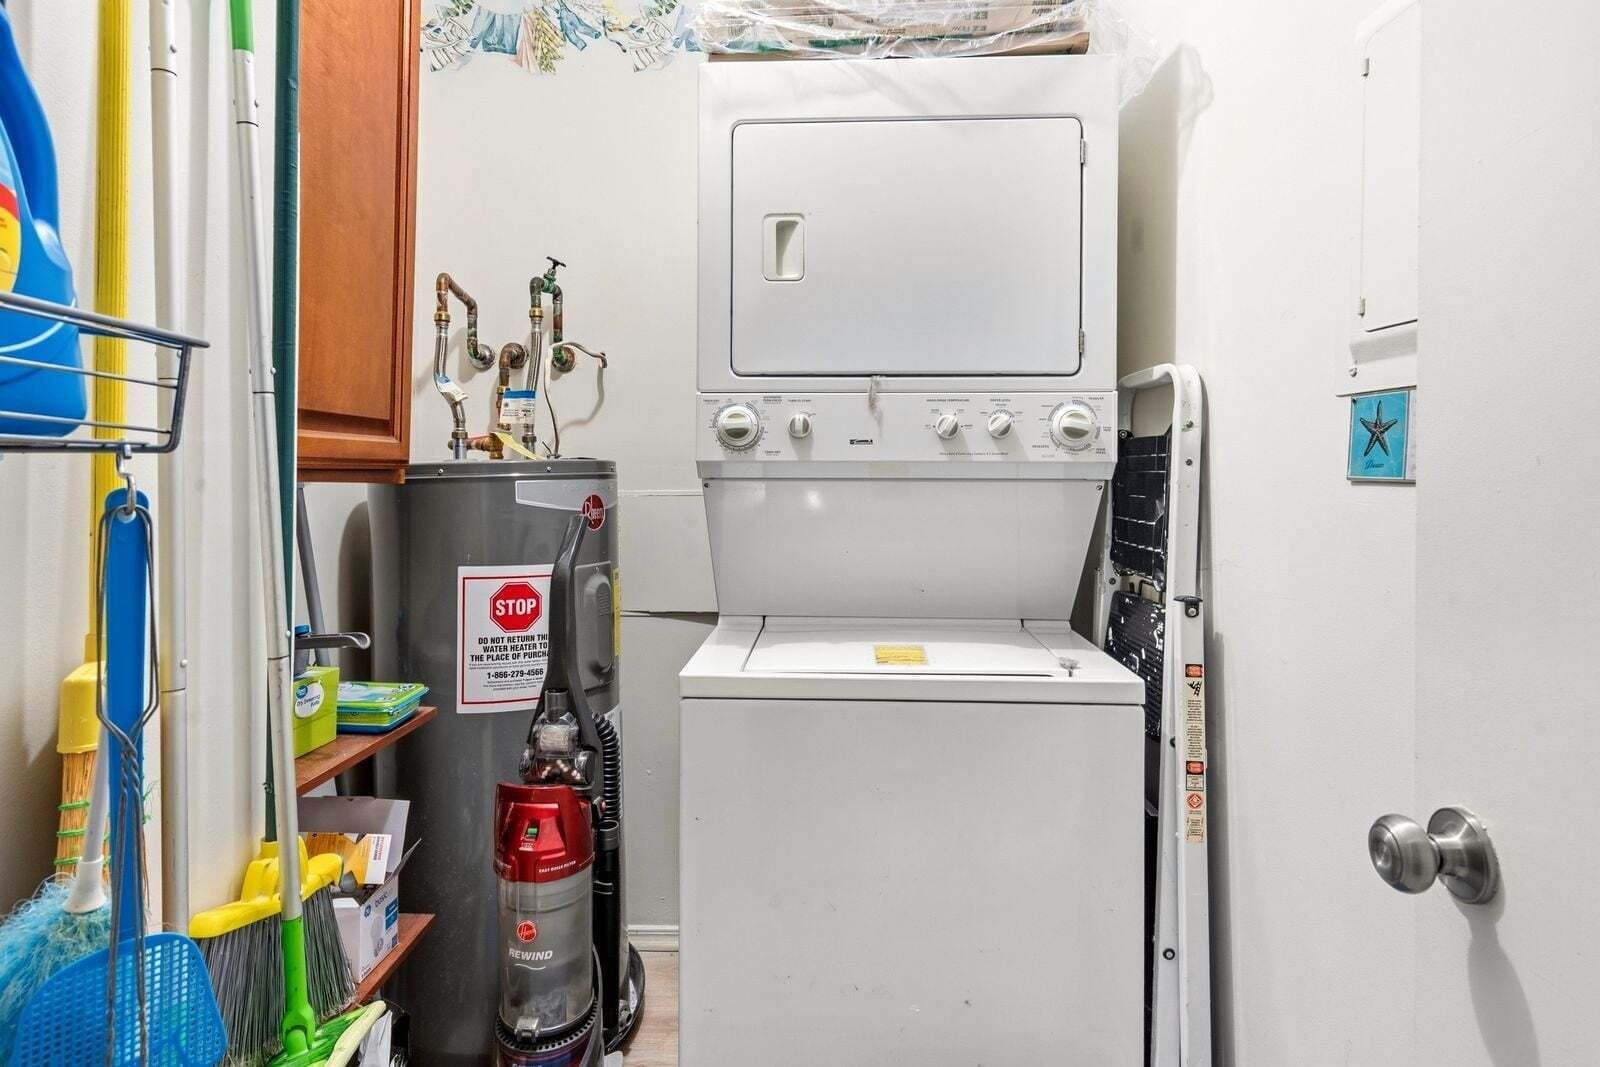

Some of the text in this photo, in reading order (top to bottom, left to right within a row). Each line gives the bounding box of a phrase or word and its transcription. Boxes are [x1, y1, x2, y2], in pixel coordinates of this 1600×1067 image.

[495, 598, 537, 617] STOP
[478, 633, 549, 645] DO NOT RETURN THI
[482, 645, 509, 653] WATER
[509, 643, 537, 652] HEATER
[470, 654, 485, 662] THE
[486, 653, 510, 661] PLACE
[511, 652, 522, 660] OF
[508, 947, 554, 961] REWIND
